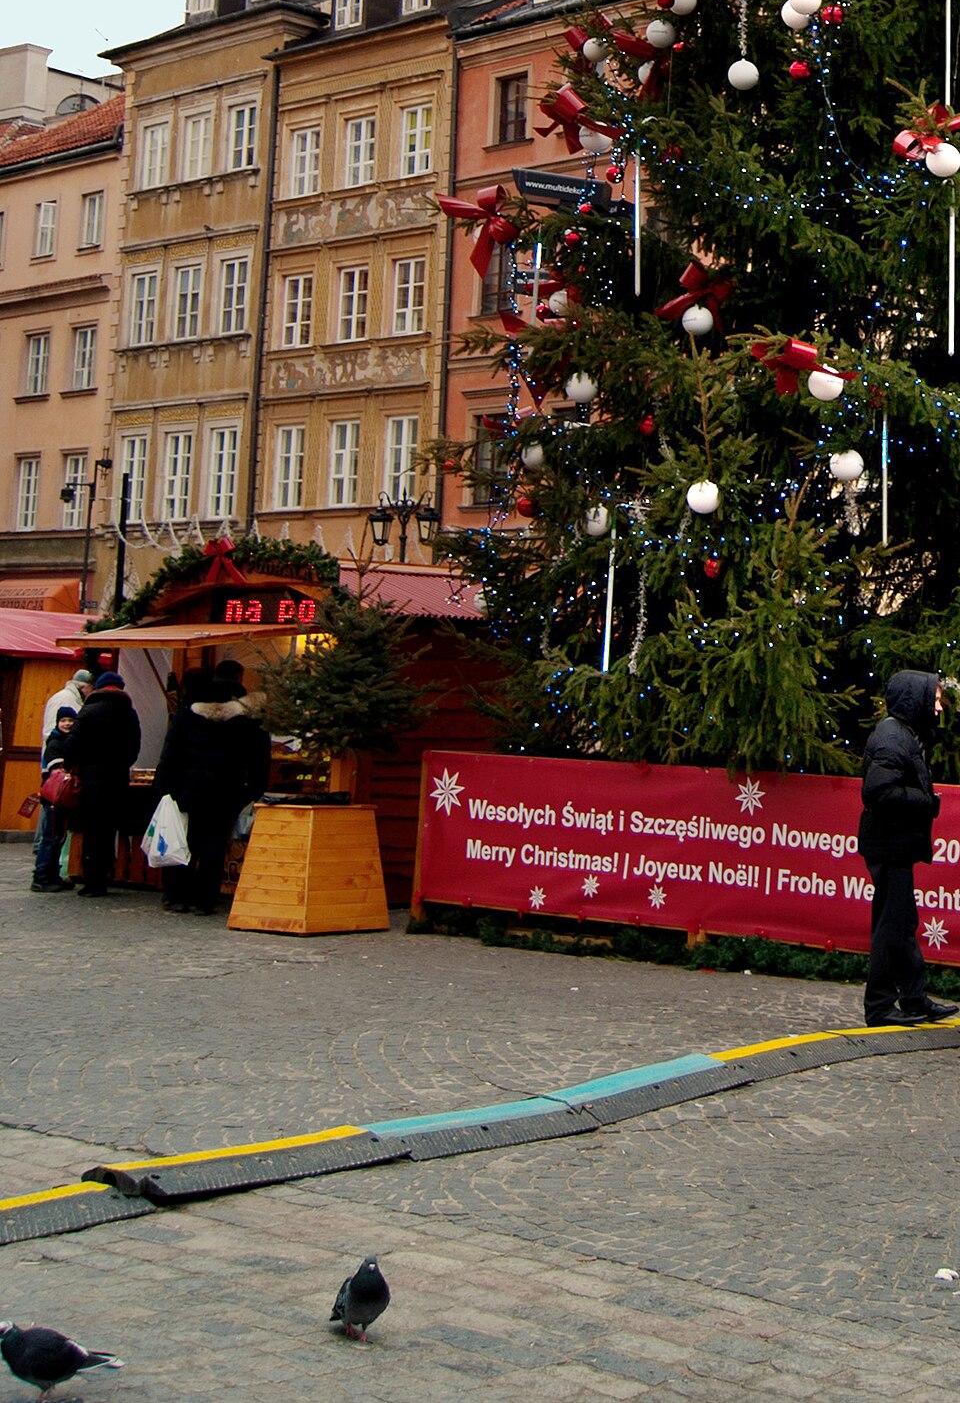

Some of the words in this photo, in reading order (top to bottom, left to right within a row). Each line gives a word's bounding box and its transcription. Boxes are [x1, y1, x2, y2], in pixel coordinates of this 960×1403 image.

[468, 798, 556, 829] Wesołych
[561, 801, 614, 835] Świąt
[619, 810, 625, 832] i
[630, 811, 766, 849] Szczęśliwego
[771, 823, 859, 858] Nowego
[466, 838, 516, 868] Merry
[520, 843, 619, 873] Christmas!
[633, 854, 703, 883] Joyeux
[708, 861, 760, 888] Noël!
[777, 868, 837, 897] Frohe
